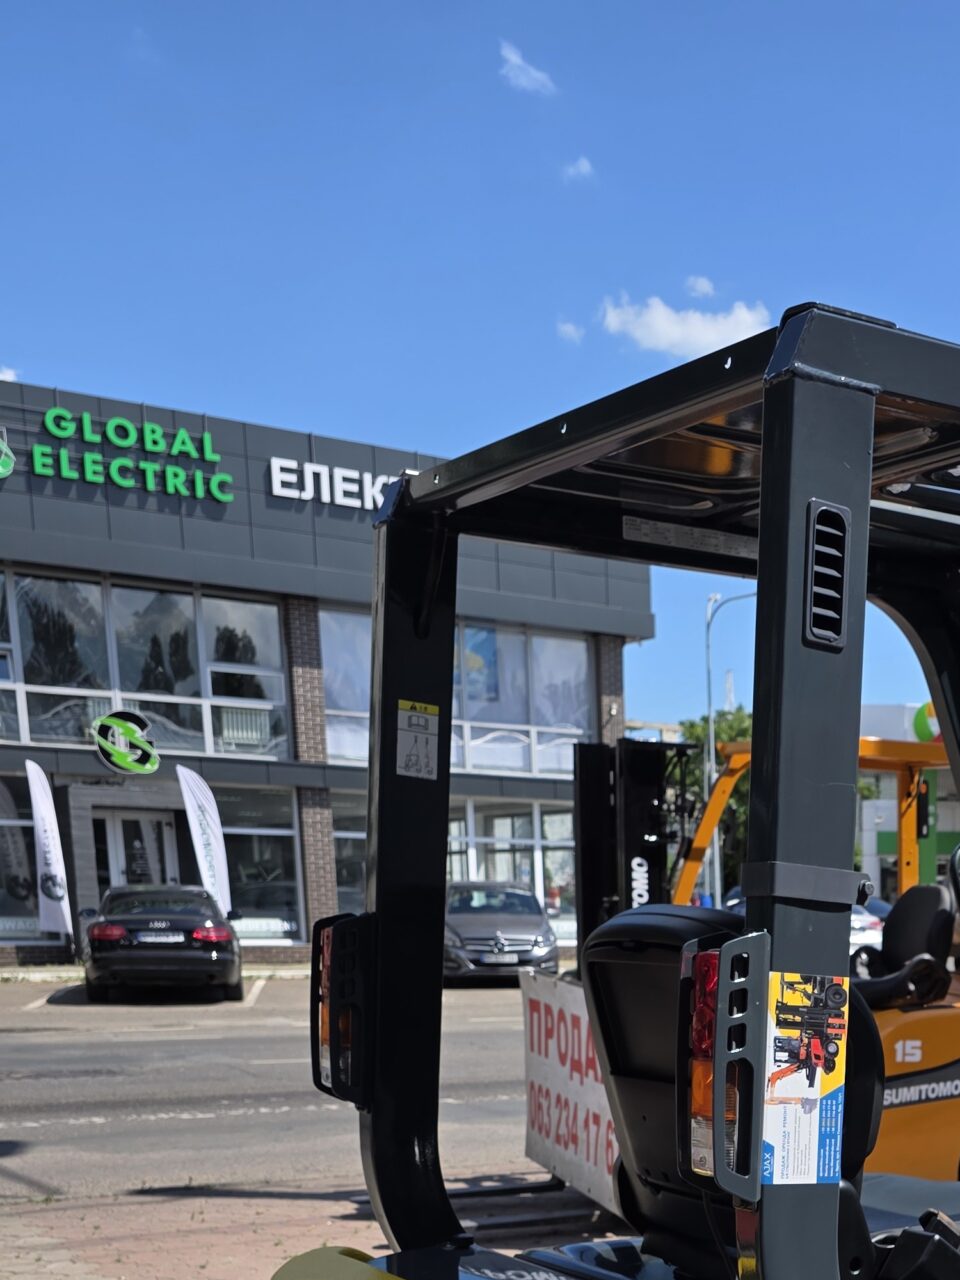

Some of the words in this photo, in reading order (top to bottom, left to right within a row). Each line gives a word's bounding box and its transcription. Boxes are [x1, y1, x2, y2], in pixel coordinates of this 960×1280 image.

[44, 406, 222, 463] GLOBAL
[32, 444, 235, 503] ELECTRIC
[528, 997, 605, 1087] ПРОДА
[894, 1040, 923, 1063] 15
[529, 1079, 551, 1141] 063
[554, 1092, 579, 1155] 234
[584, 1108, 601, 1167] 17
[605, 1119, 619, 1176] 6
[763, 1152, 772, 1177] AJAX
